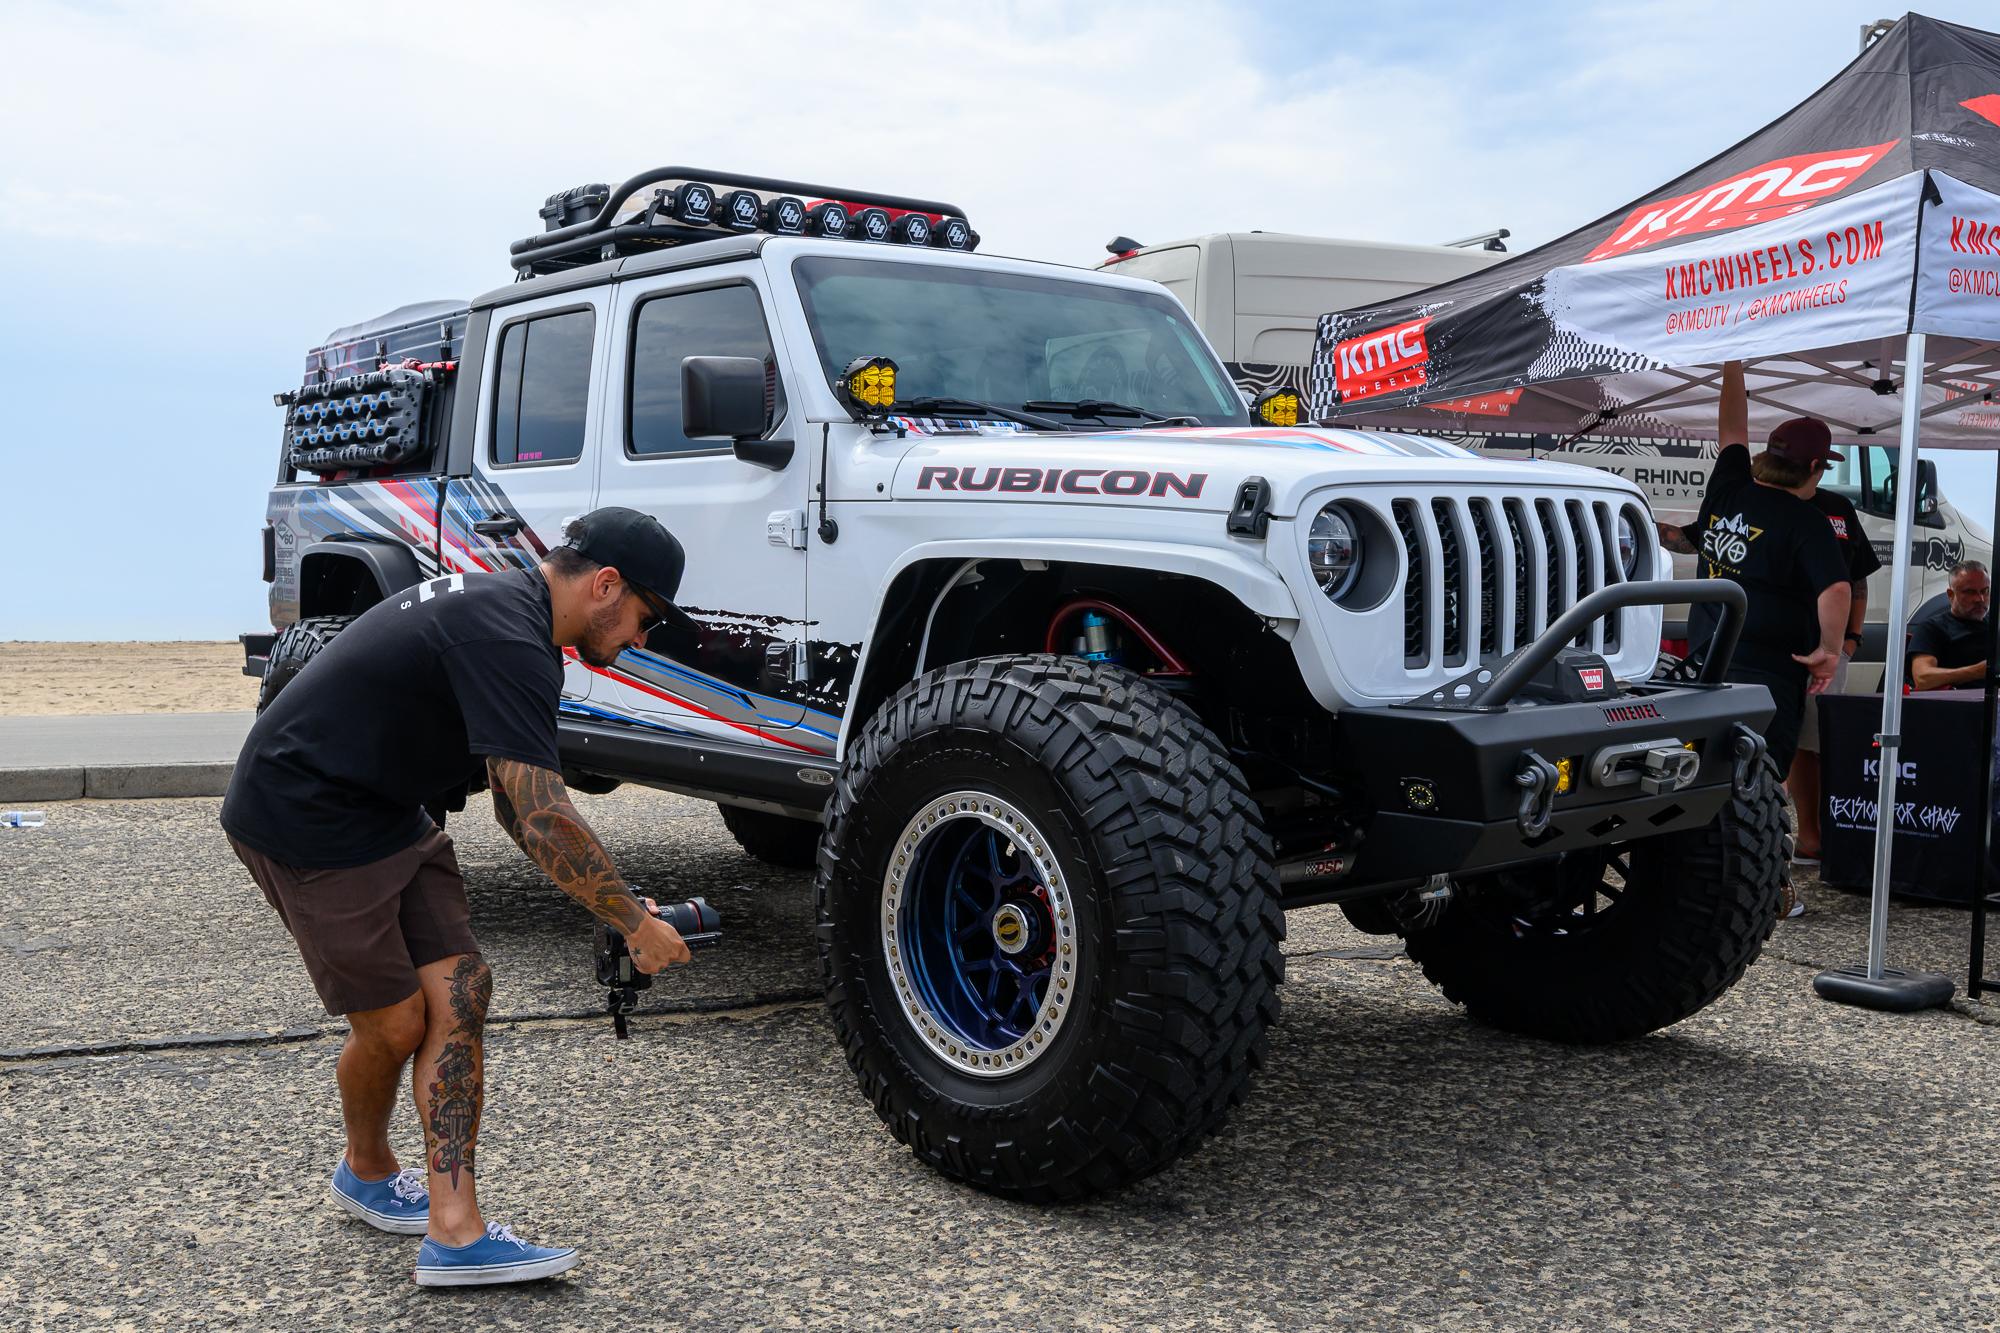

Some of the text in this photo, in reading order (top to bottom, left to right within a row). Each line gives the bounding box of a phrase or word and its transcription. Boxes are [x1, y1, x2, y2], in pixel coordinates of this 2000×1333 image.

[1613, 153, 1873, 245] KMC
[1665, 221, 1884, 300] KMCWHEELS.COM
[1666, 304, 1730, 335] @KMCUTV
[1747, 279, 1848, 321] @KMCWHEELS
[1340, 323, 1423, 380] KMC
[1342, 369, 1426, 398] WHEELS
[916, 466, 1208, 499] RUBICON
[1634, 468, 1706, 487] RHINO
[1652, 487, 1705, 499] LOYS
[1704, 529, 1748, 563] EVO
[1863, 759, 1917, 779] KC
[1863, 777, 1917, 786] WHLS
[1919, 804, 1961, 834] CHAOS
[1314, 860, 1344, 875] PSC
